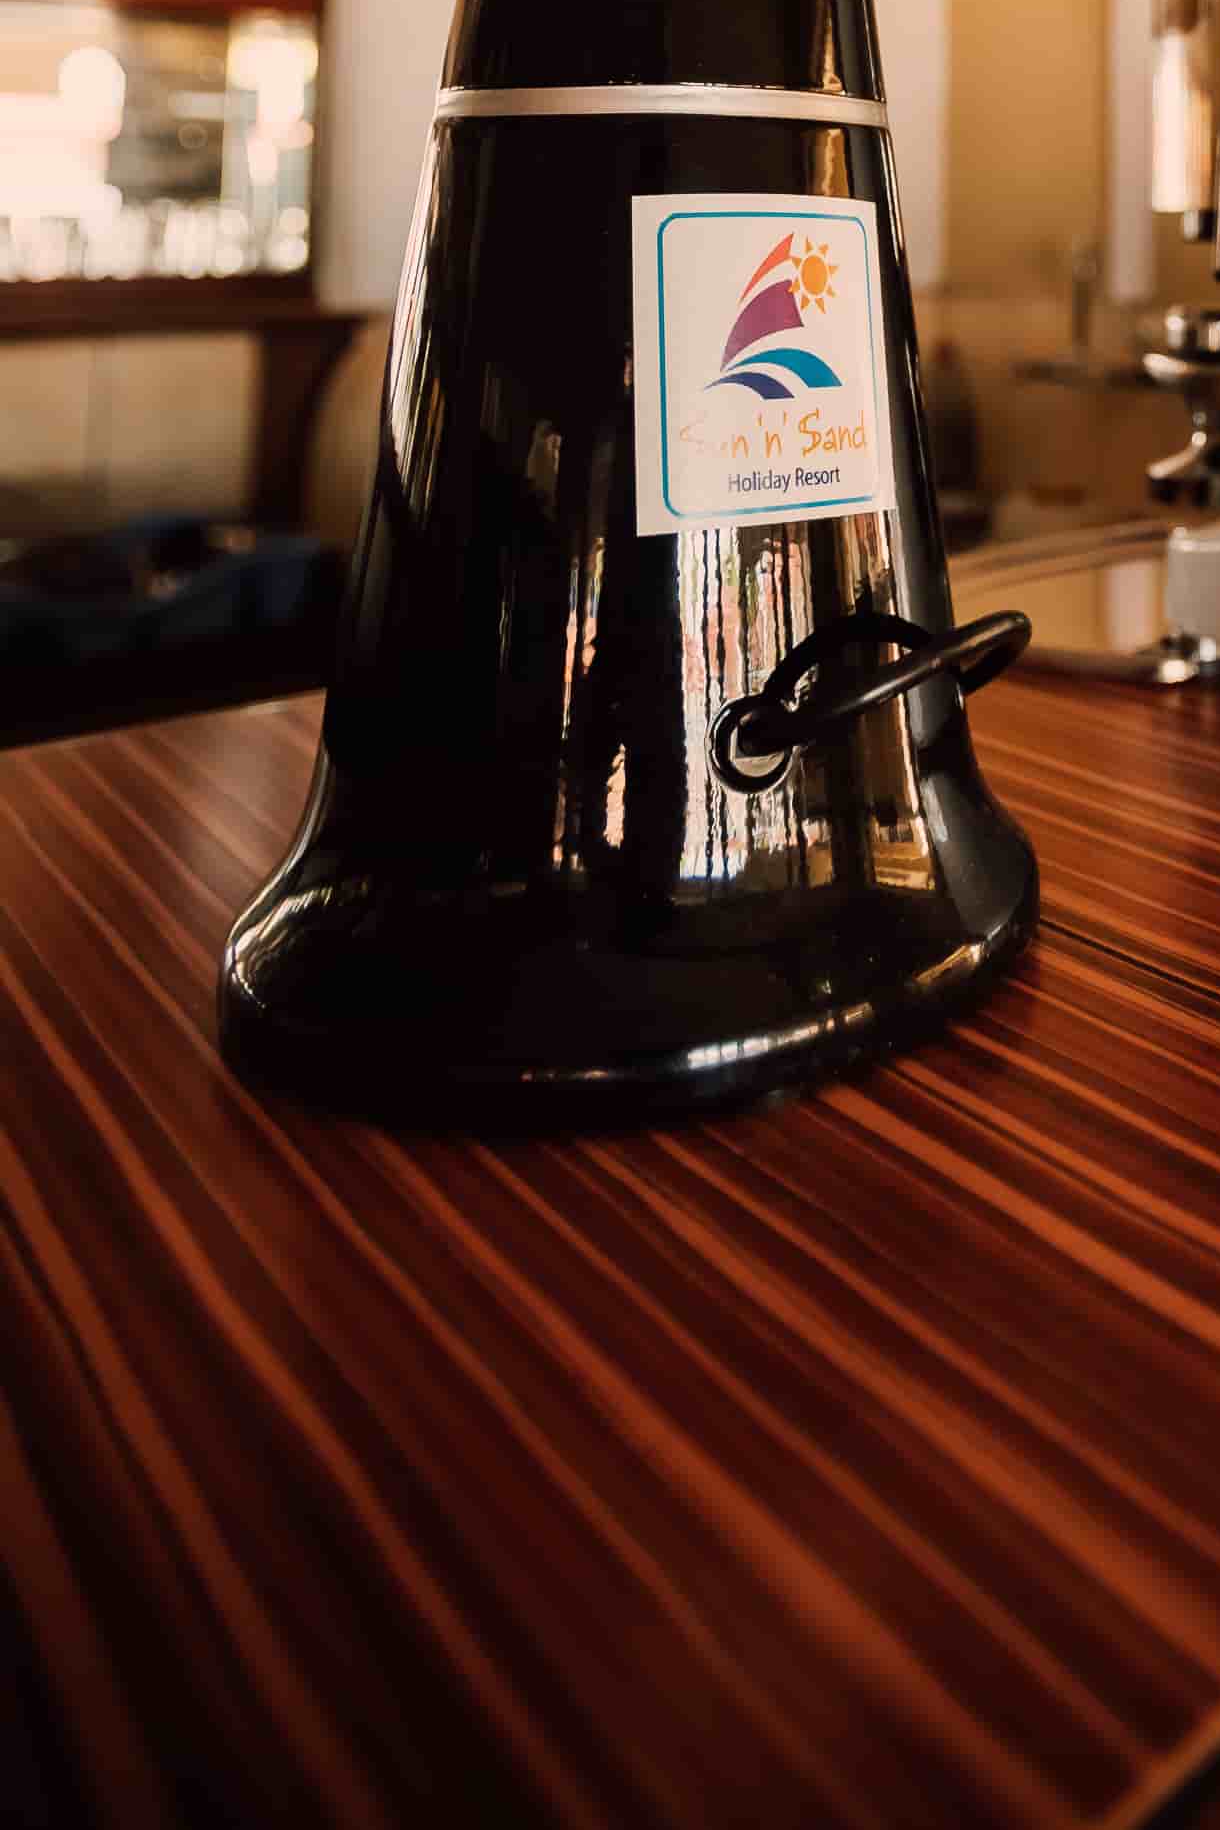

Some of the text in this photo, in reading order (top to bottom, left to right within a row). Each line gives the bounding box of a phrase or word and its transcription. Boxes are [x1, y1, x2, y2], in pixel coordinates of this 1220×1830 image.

[798, 408, 867, 457] Sand
[728, 467, 841, 493] Holiday Resort
